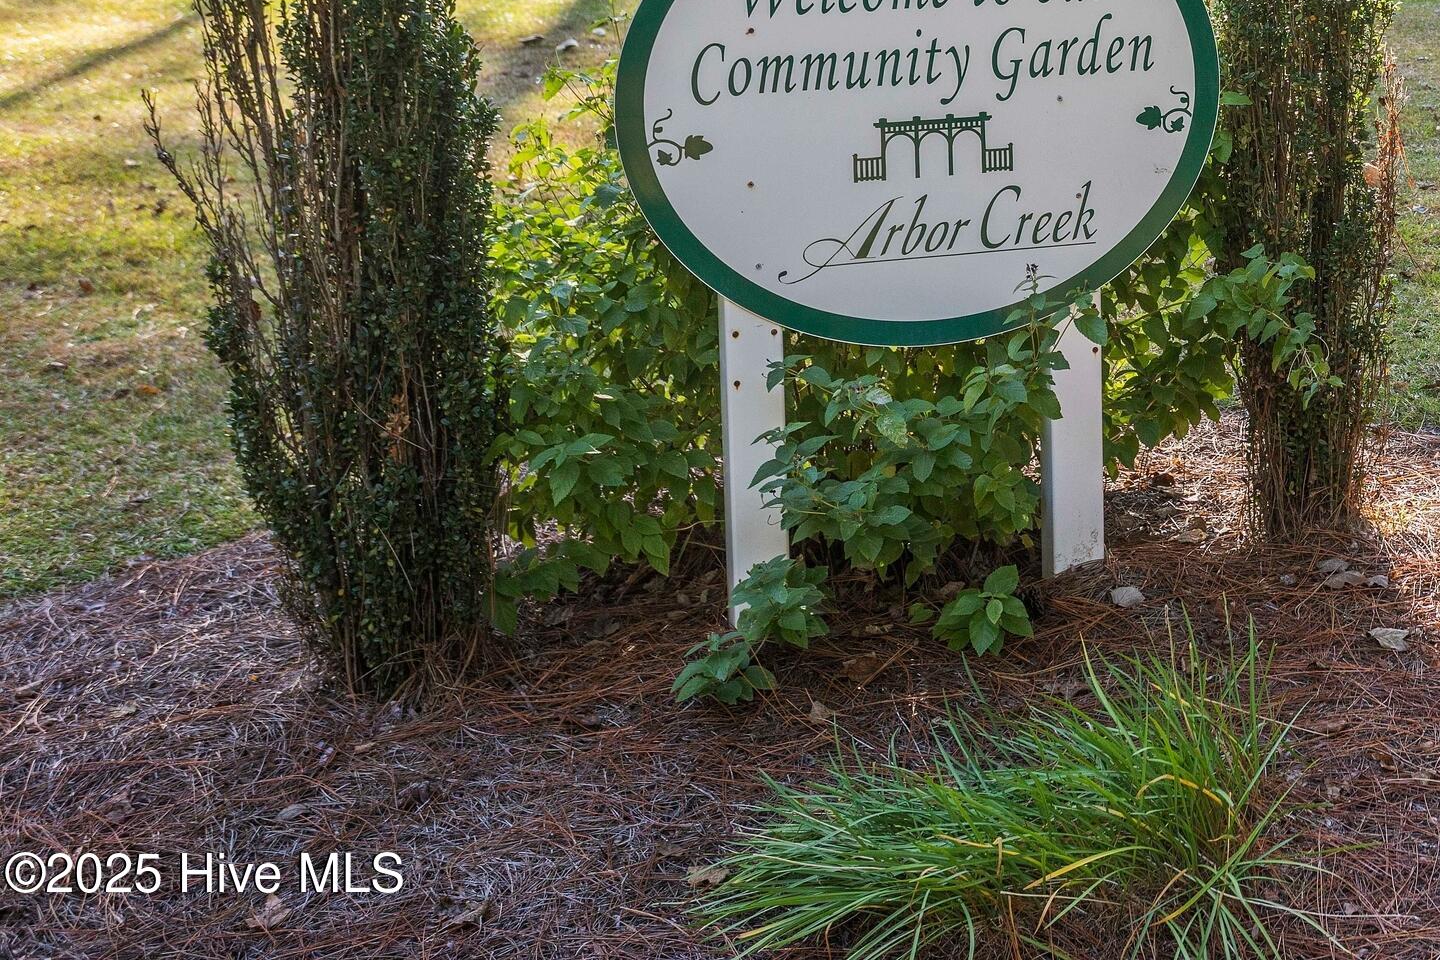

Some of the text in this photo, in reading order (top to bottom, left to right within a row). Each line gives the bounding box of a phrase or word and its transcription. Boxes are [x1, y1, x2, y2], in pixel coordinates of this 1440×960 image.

[690, 13, 1155, 106] Community Garden
[800, 180, 1098, 268] Arbor Creek
